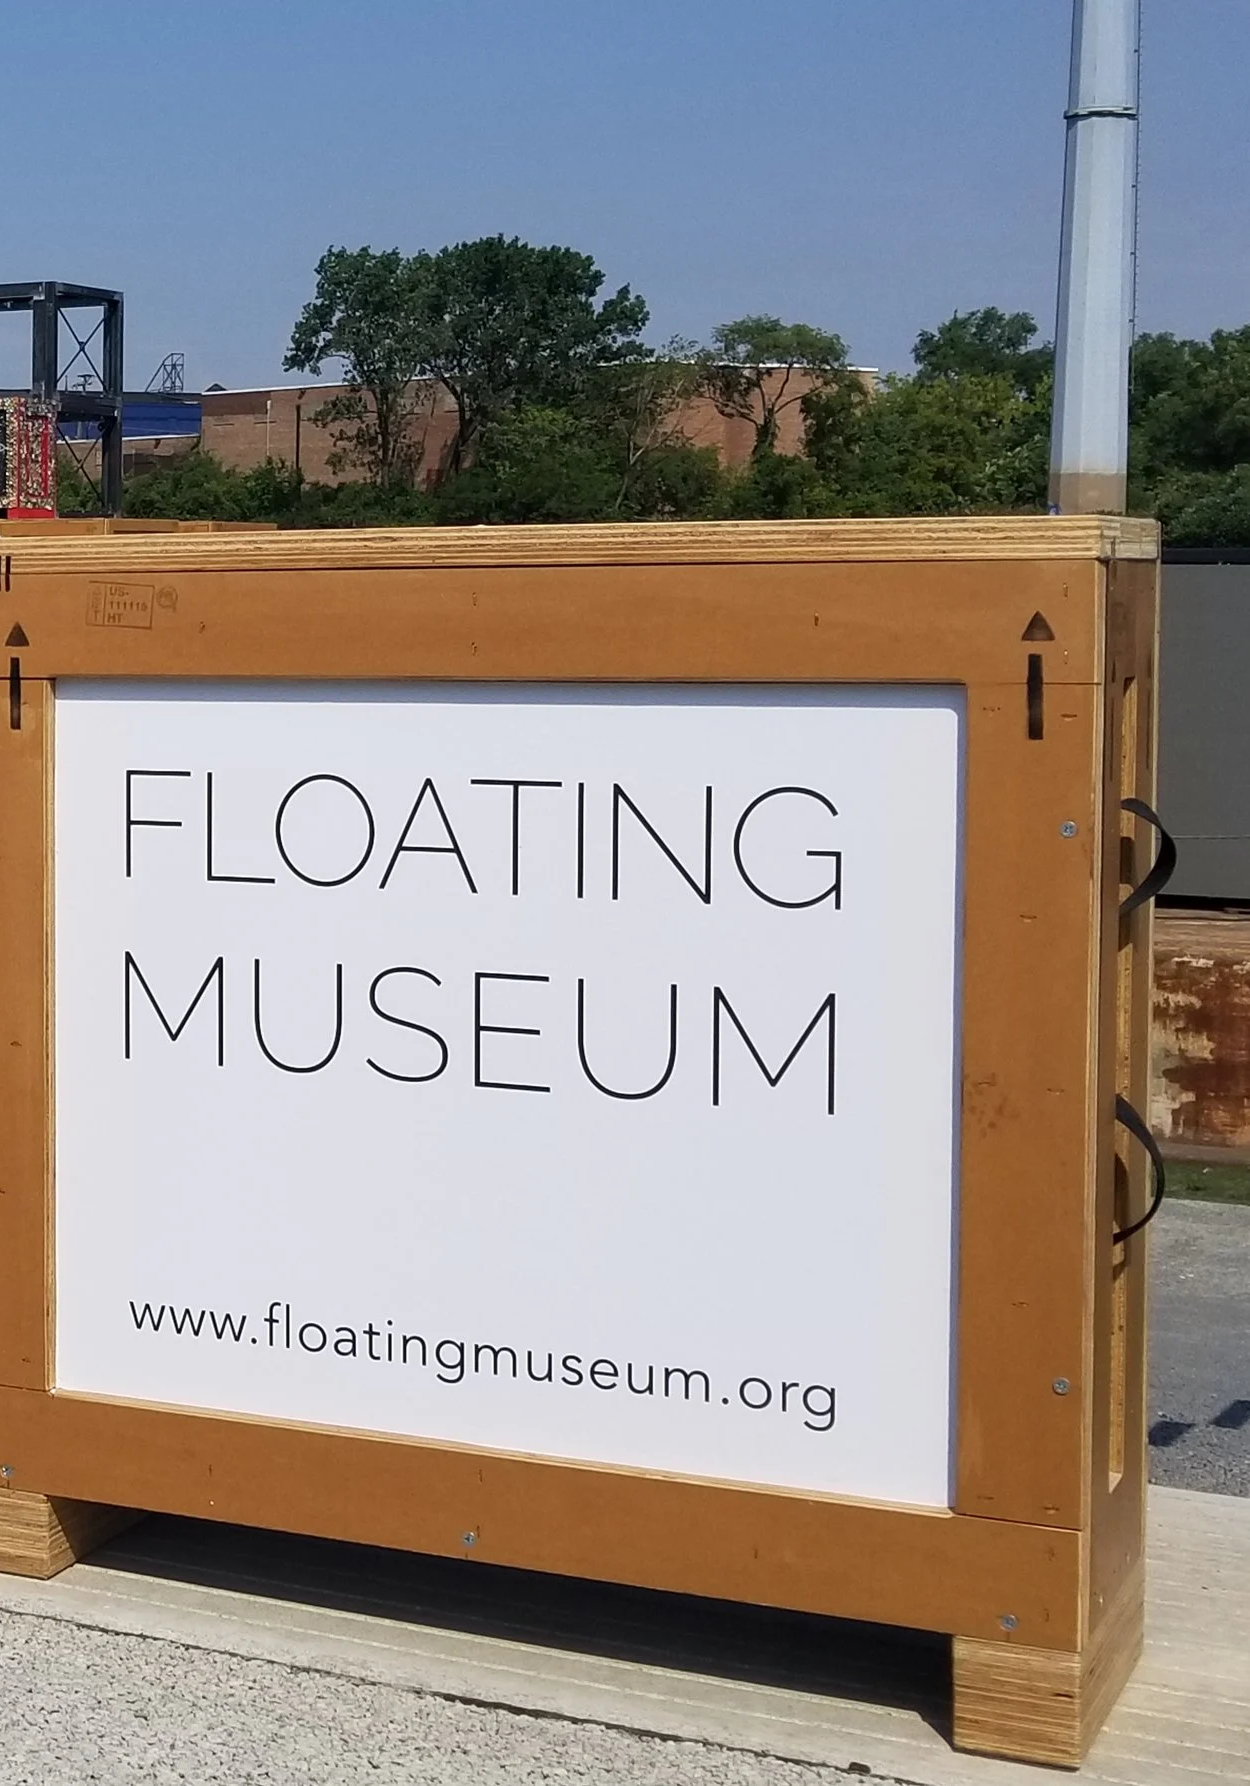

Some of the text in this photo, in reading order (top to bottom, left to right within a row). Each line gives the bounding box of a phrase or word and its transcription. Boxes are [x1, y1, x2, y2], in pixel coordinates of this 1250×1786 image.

[126, 769, 842, 910] FLOATING
[124, 950, 836, 1115] MUSEUM
[129, 1301, 836, 1432] www.floatingmuseum.org
